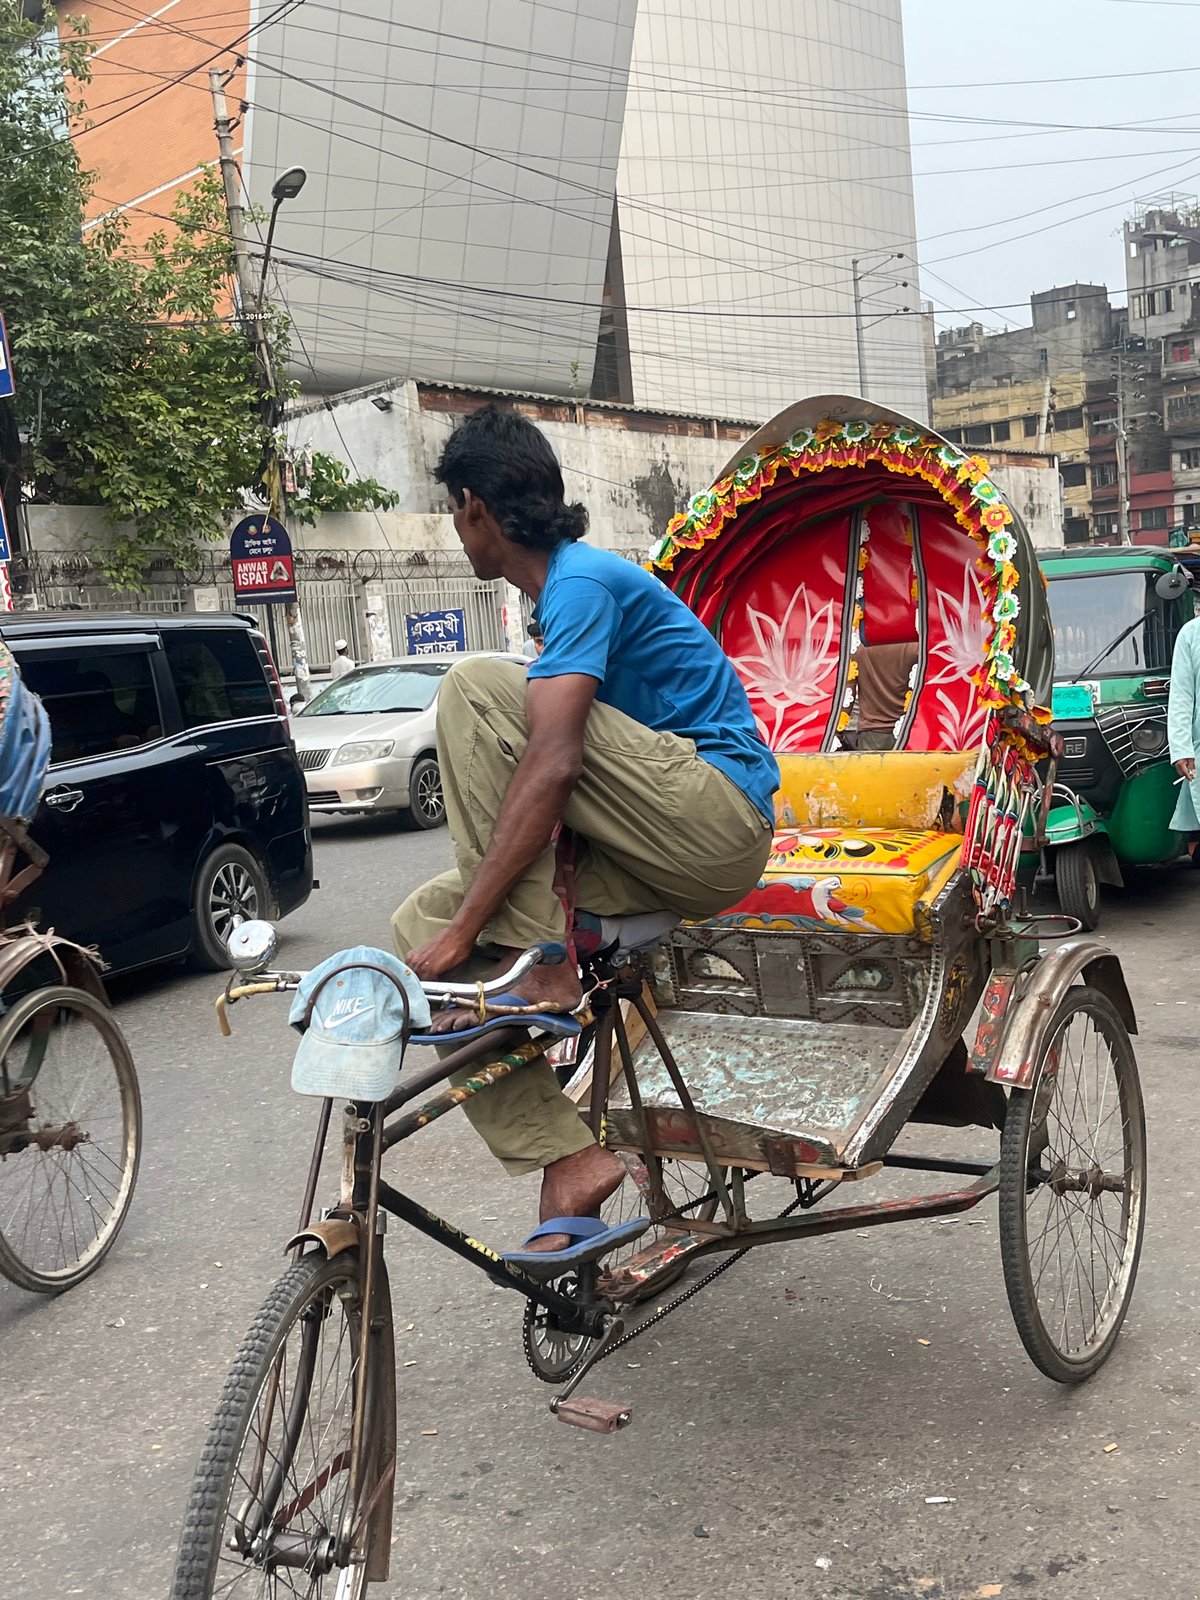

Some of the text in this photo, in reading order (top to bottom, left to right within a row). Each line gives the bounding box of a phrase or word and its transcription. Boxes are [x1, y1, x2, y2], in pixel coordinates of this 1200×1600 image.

[238, 561, 267, 573] ANWAR
[238, 572, 268, 586] ISPAT
[413, 613, 459, 638] একমুখী
[1066, 743, 1083, 754] RE
[333, 996, 365, 1016] NIKE
